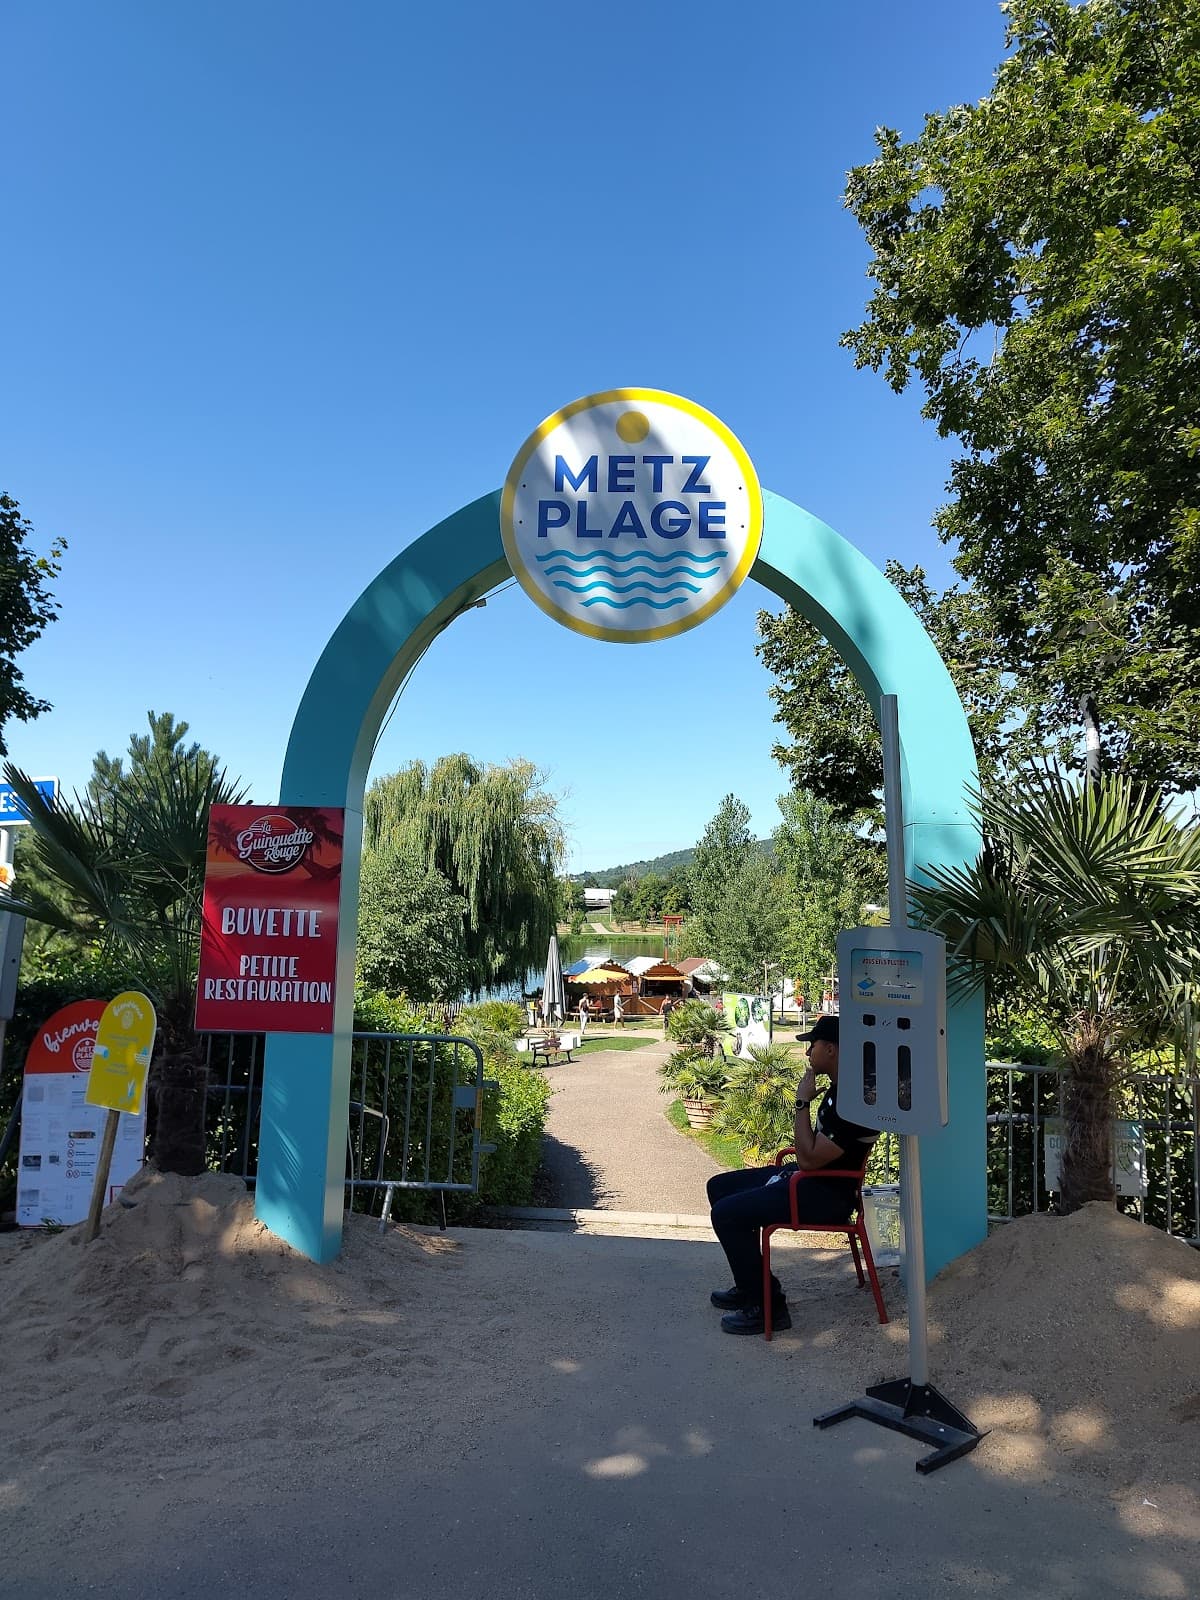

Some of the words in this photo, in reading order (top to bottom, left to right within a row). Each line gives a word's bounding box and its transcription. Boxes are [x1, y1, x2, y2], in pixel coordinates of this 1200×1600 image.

[554, 455, 712, 493] METZ
[537, 500, 727, 539] PLAGE
[236, 827, 314, 859] Guinguette
[261, 820, 273, 835] La
[264, 845, 300, 863] Rouge
[221, 907, 323, 938] BUVETTE
[240, 954, 300, 978] PETITE
[204, 978, 332, 1004] RESTAURATION
[43, 1018, 100, 1053] bienve
